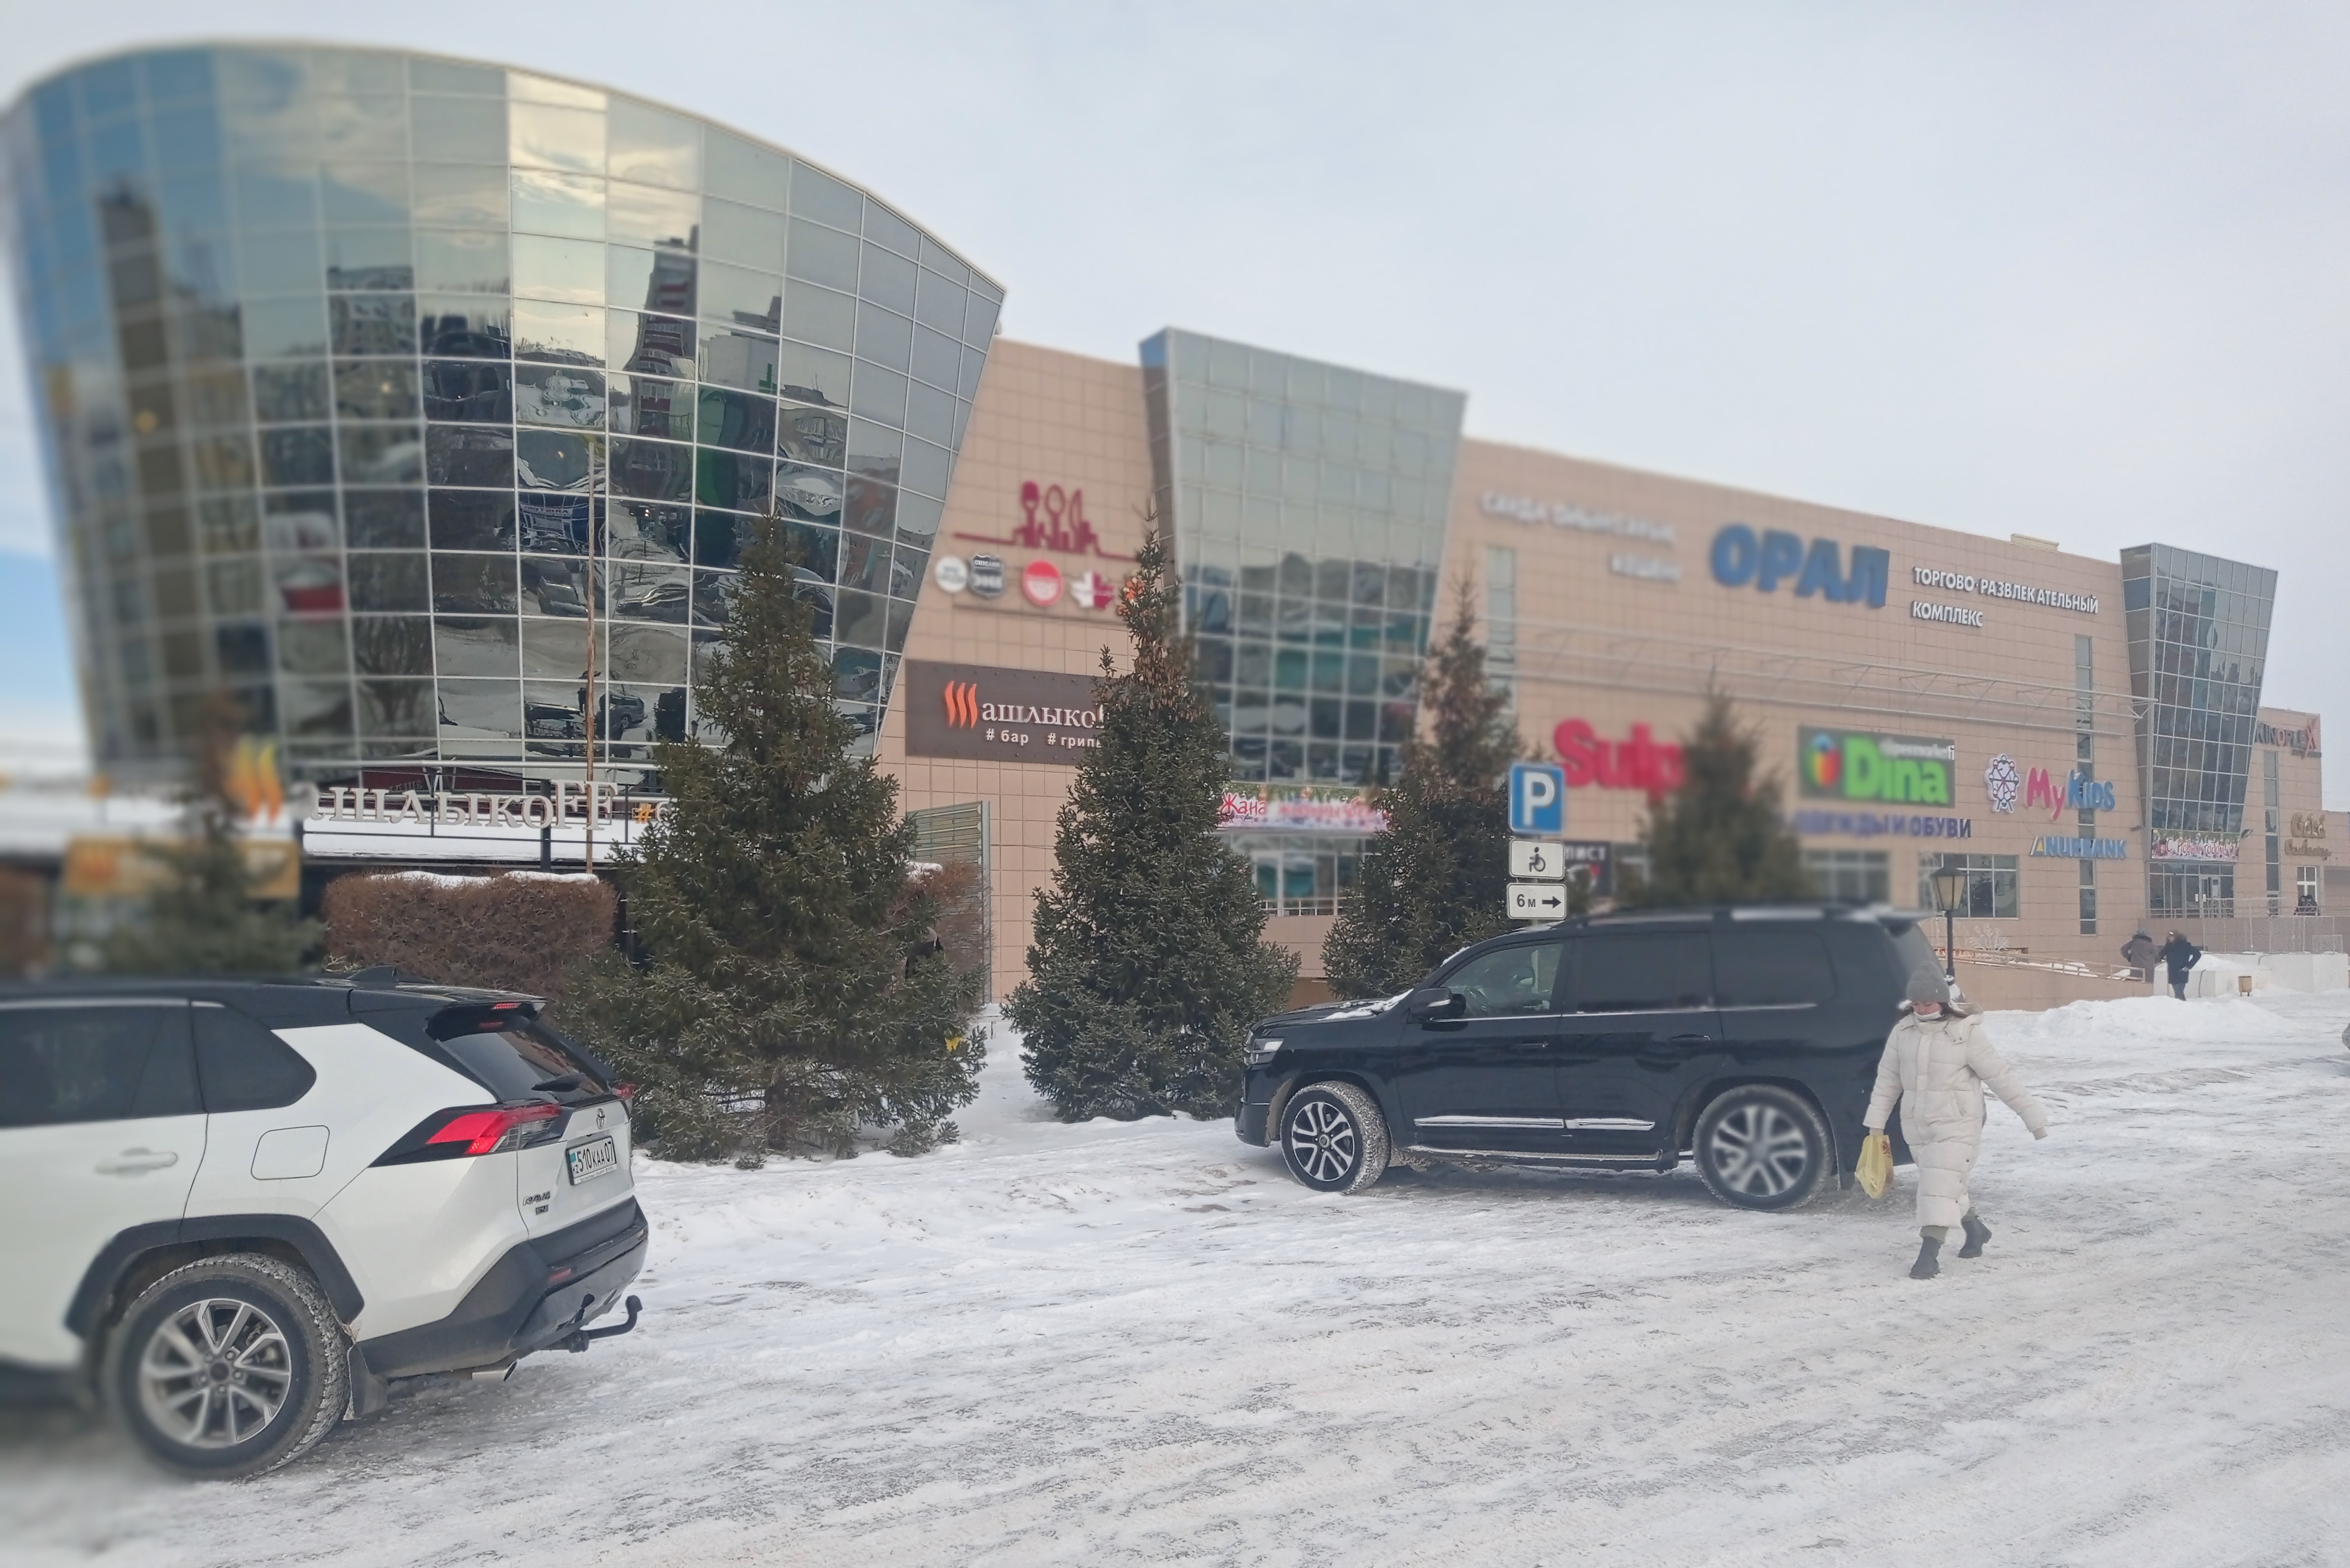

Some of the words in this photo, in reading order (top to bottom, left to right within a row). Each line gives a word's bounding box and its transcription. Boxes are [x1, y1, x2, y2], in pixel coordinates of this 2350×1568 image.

[1711, 523, 1889, 609] ОРАЛ
[1912, 601, 1983, 627] КОМПЛЕКС
[1844, 736, 1948, 805] Dina
[1523, 772, 1556, 827] P
[1908, 815, 1971, 839] ОБУВИ
[523, 1191, 550, 1206] RAV4
